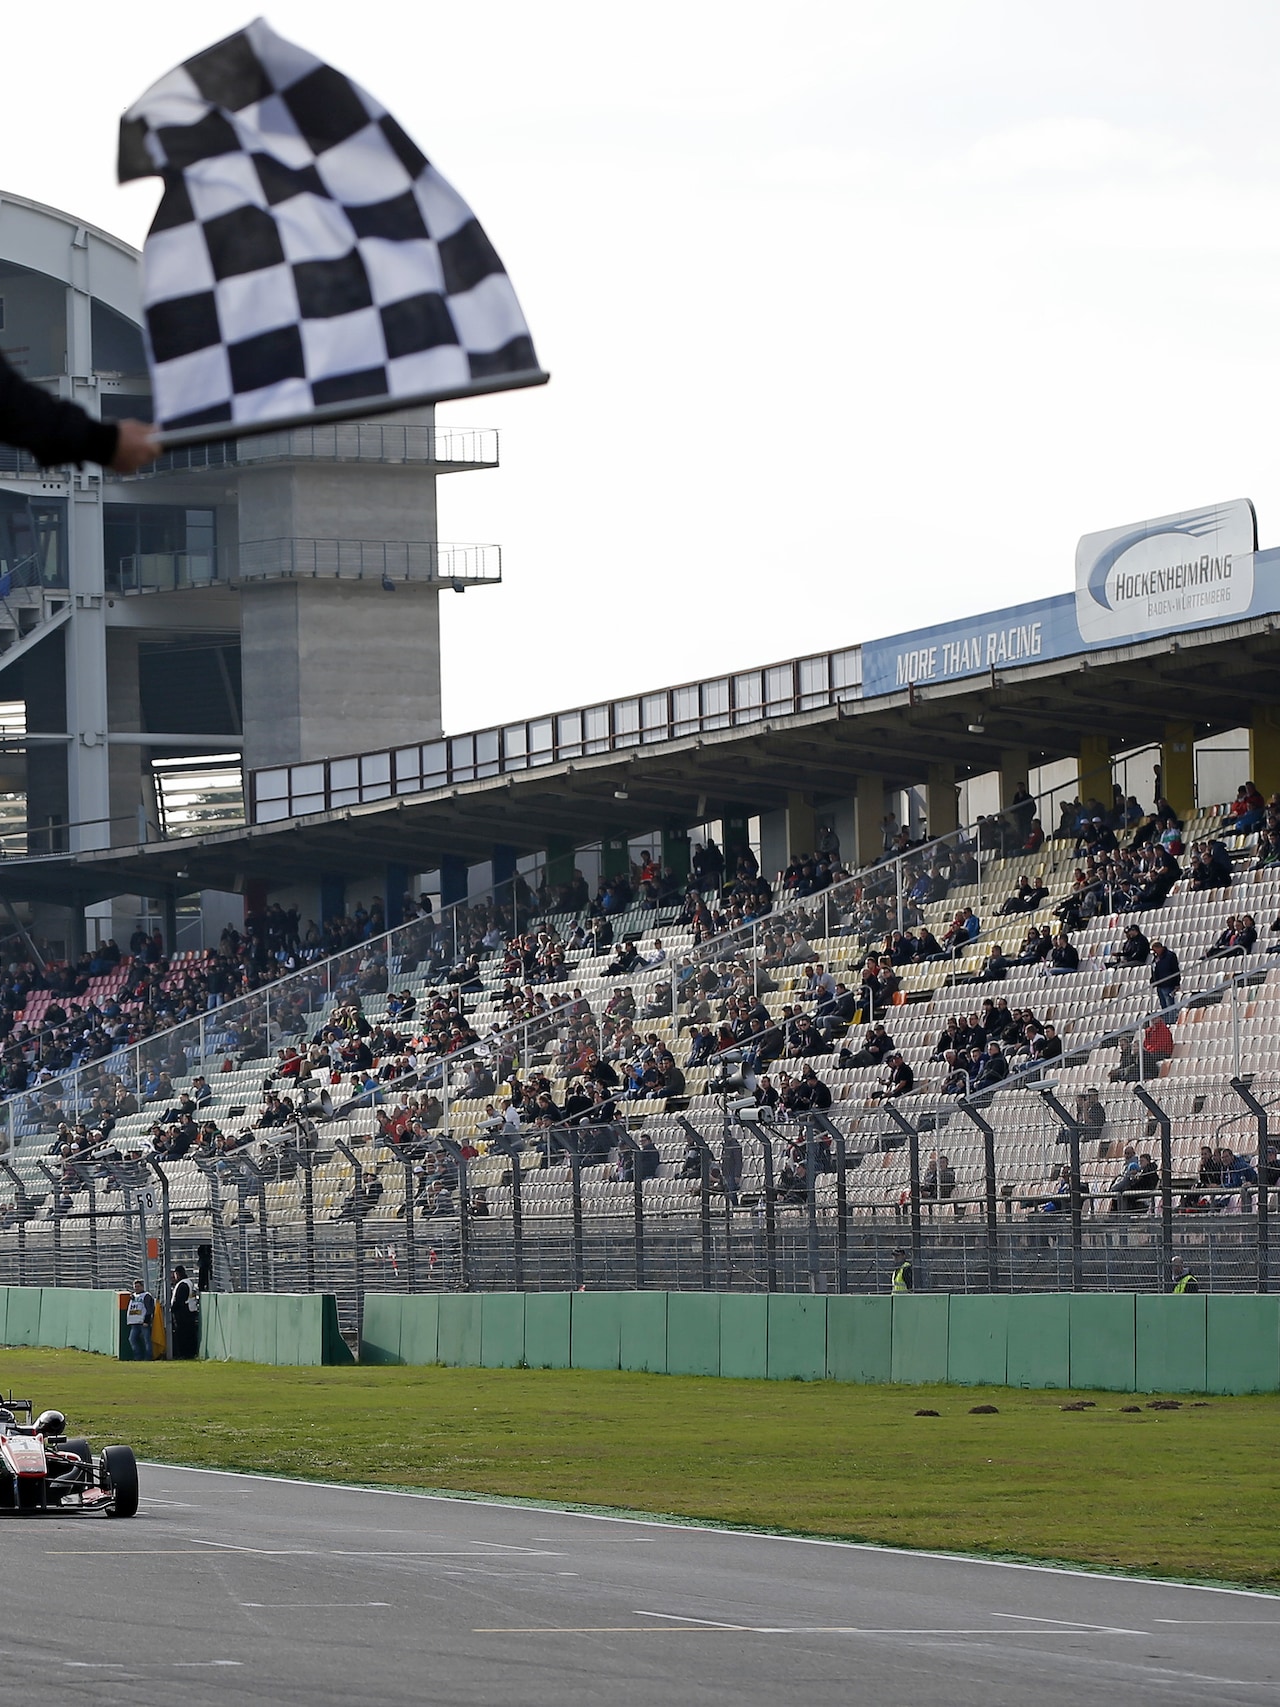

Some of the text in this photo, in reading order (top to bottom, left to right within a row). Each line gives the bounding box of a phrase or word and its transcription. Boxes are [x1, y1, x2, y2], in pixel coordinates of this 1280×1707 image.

[1116, 554, 1233, 601] HOCKENHEIMRING
[895, 622, 1042, 686] MORE THAN RACING
[136, 1192, 153, 1209] 58
